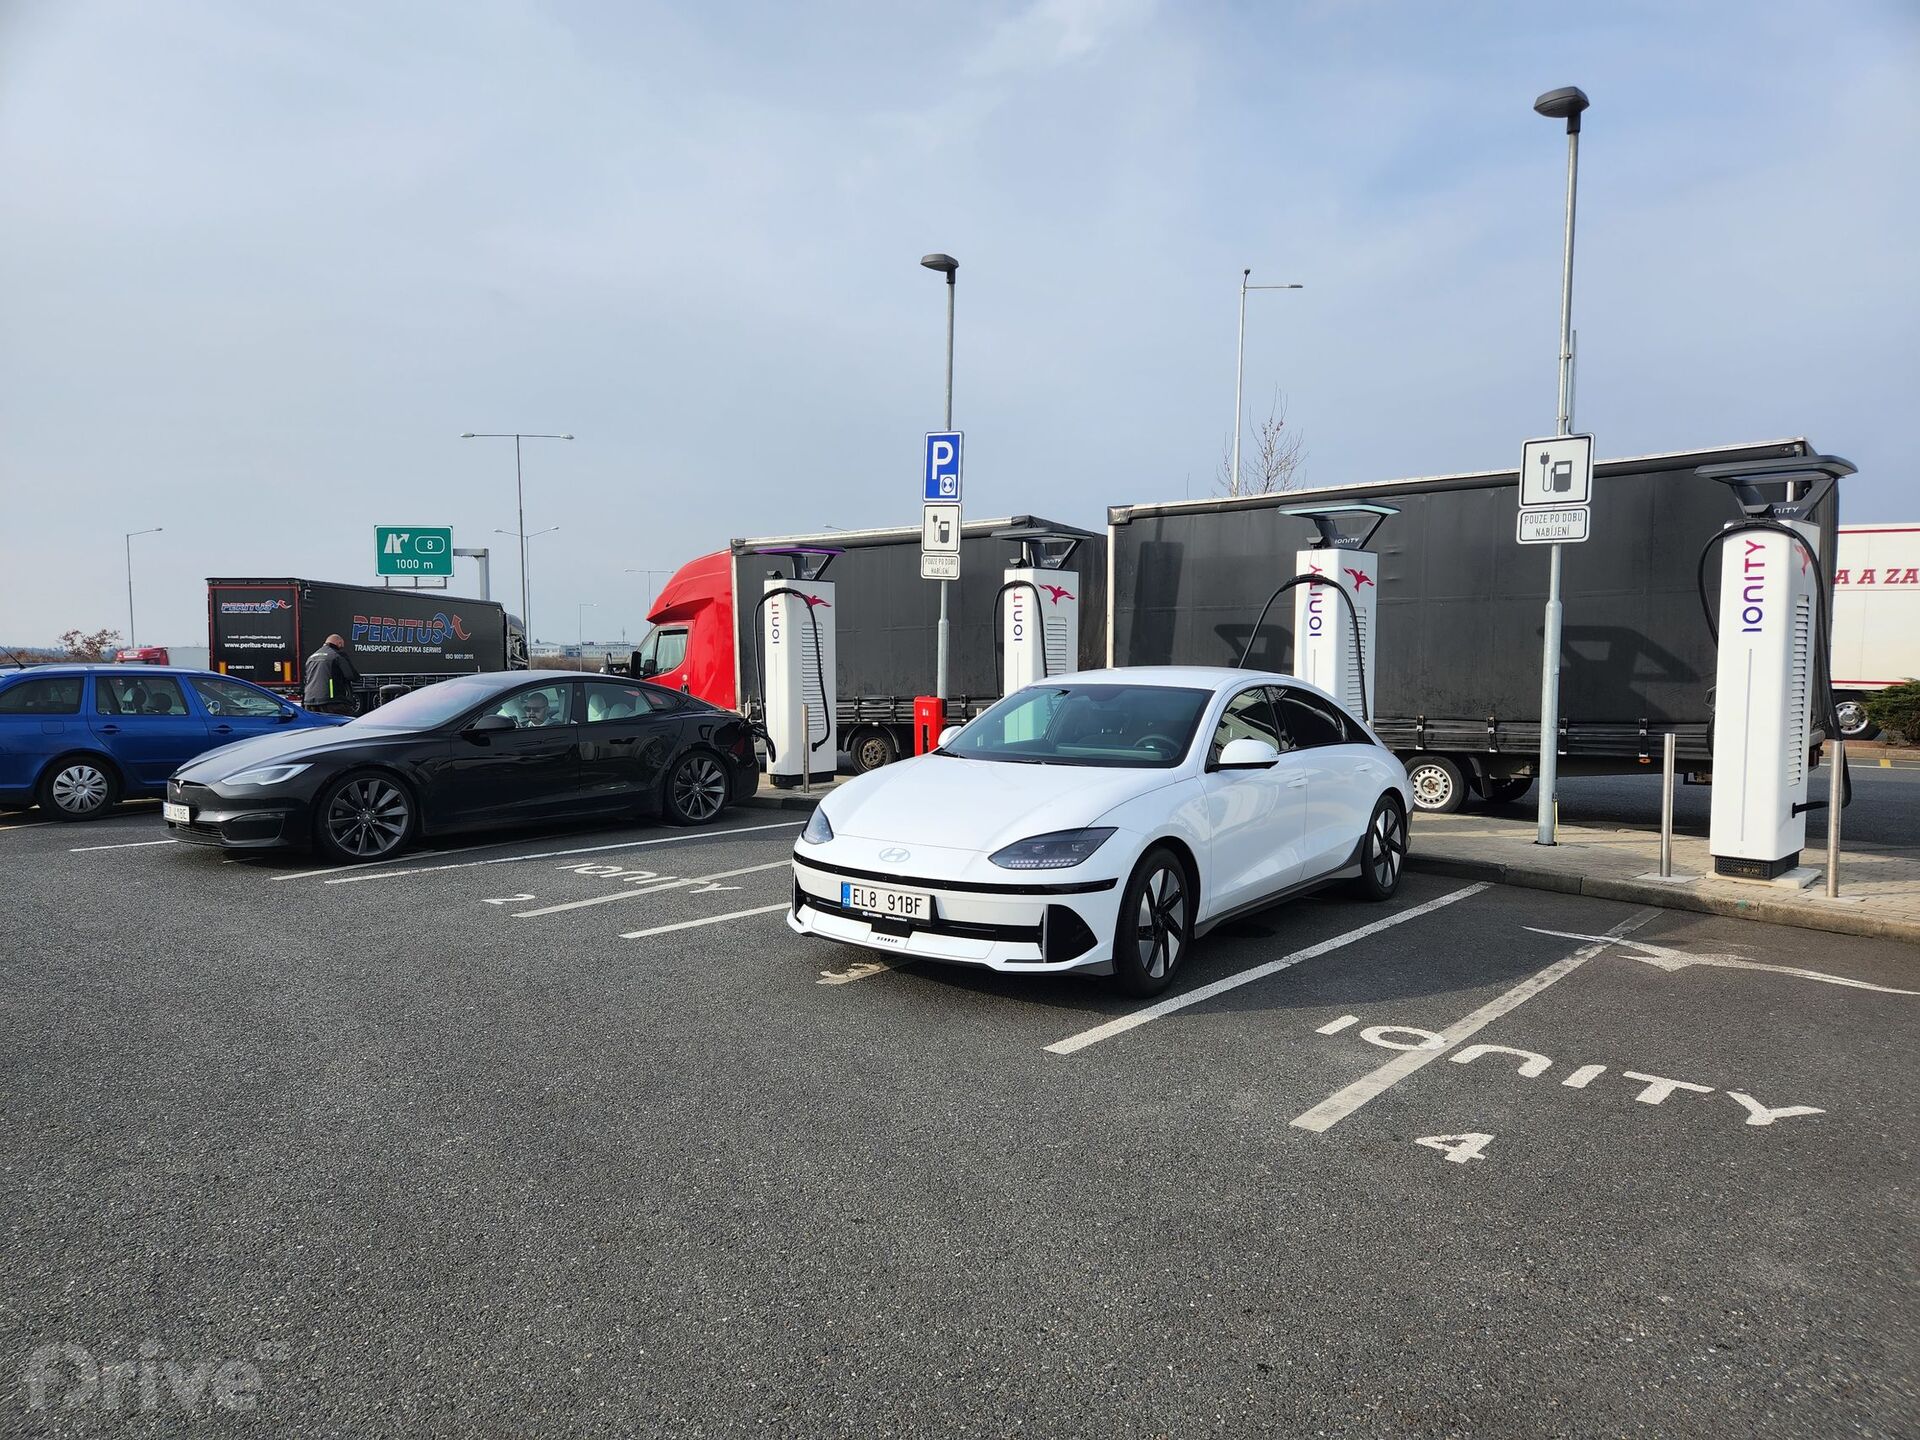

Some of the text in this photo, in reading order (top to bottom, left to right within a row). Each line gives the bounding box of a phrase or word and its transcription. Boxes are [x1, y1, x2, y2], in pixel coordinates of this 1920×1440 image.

[931, 440, 954, 480] P
[1524, 512, 1583, 524] POUZE PO DOBU
[1773, 506, 1799, 514] NITY
[1536, 524, 1570, 537] NABÍJENÍ
[427, 540, 434, 550] 8
[396, 559, 434, 569] 1000 m
[1742, 540, 1766, 632] IONITY
[771, 594, 780, 644] IONIT
[1013, 585, 1023, 641] IONIT
[351, 615, 444, 645] PERITUS
[354, 644, 442, 654] TRANSPORT LOGISTYKA SERWIS
[853, 888, 922, 915] EL8 91BF
[1315, 1014, 1827, 1126] IONITY
[1414, 1132, 1495, 1164] 4
